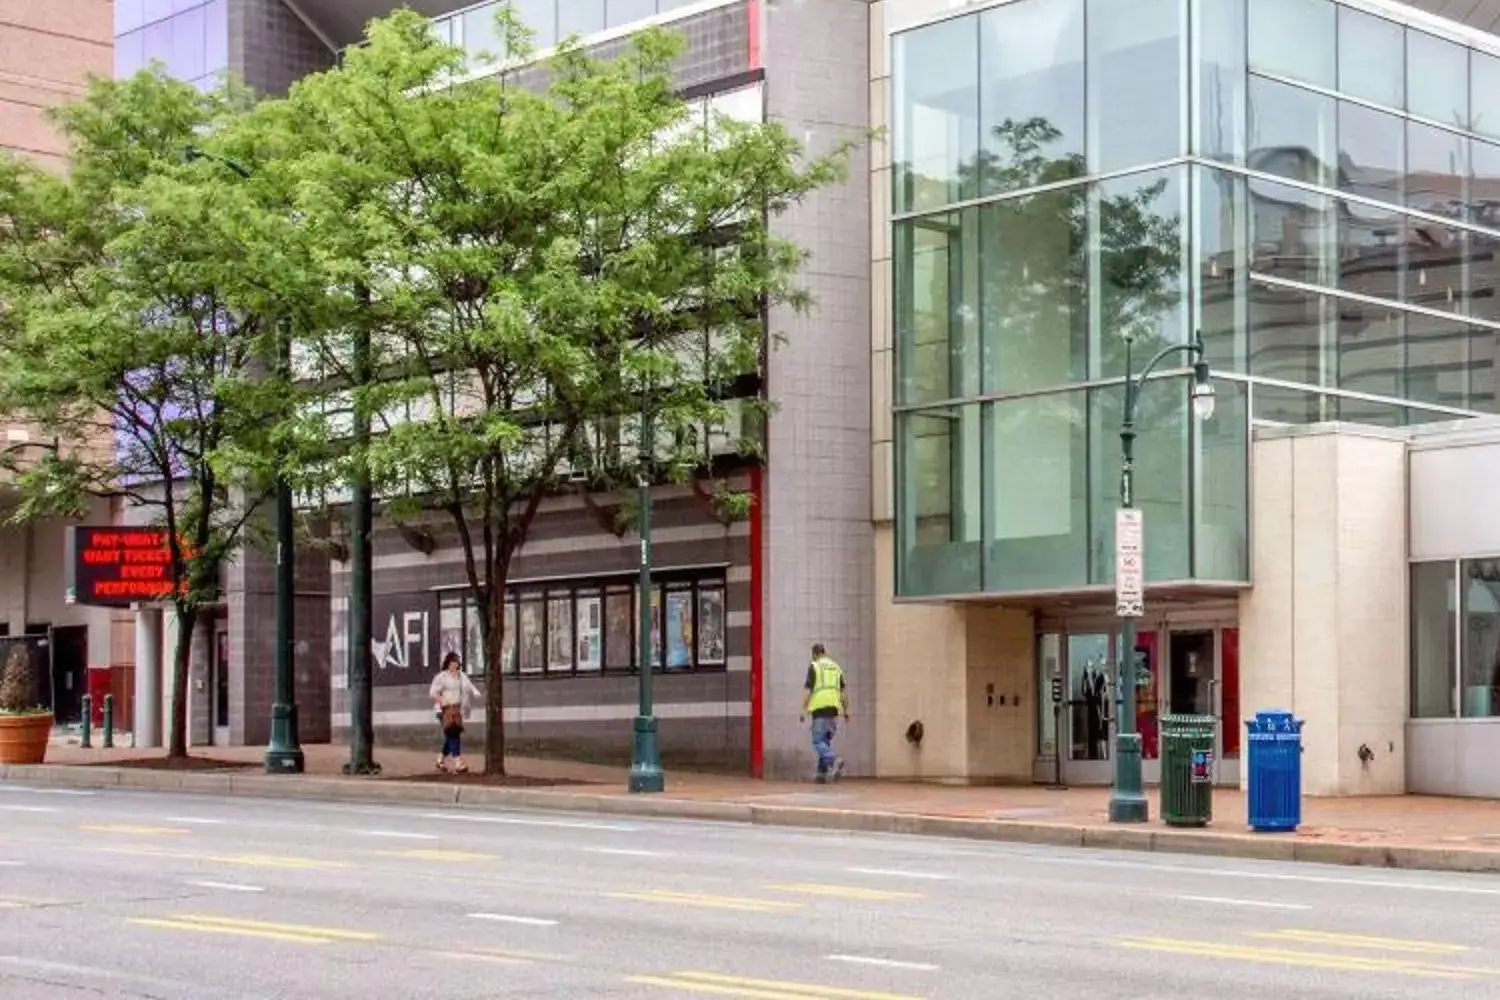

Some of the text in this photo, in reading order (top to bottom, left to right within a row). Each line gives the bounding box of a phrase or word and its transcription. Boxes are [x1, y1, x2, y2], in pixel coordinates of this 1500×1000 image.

[120, 565, 164, 579] EVERY
[94, 580, 190, 596] PERFORMANE
[381, 611, 429, 668] AFI
